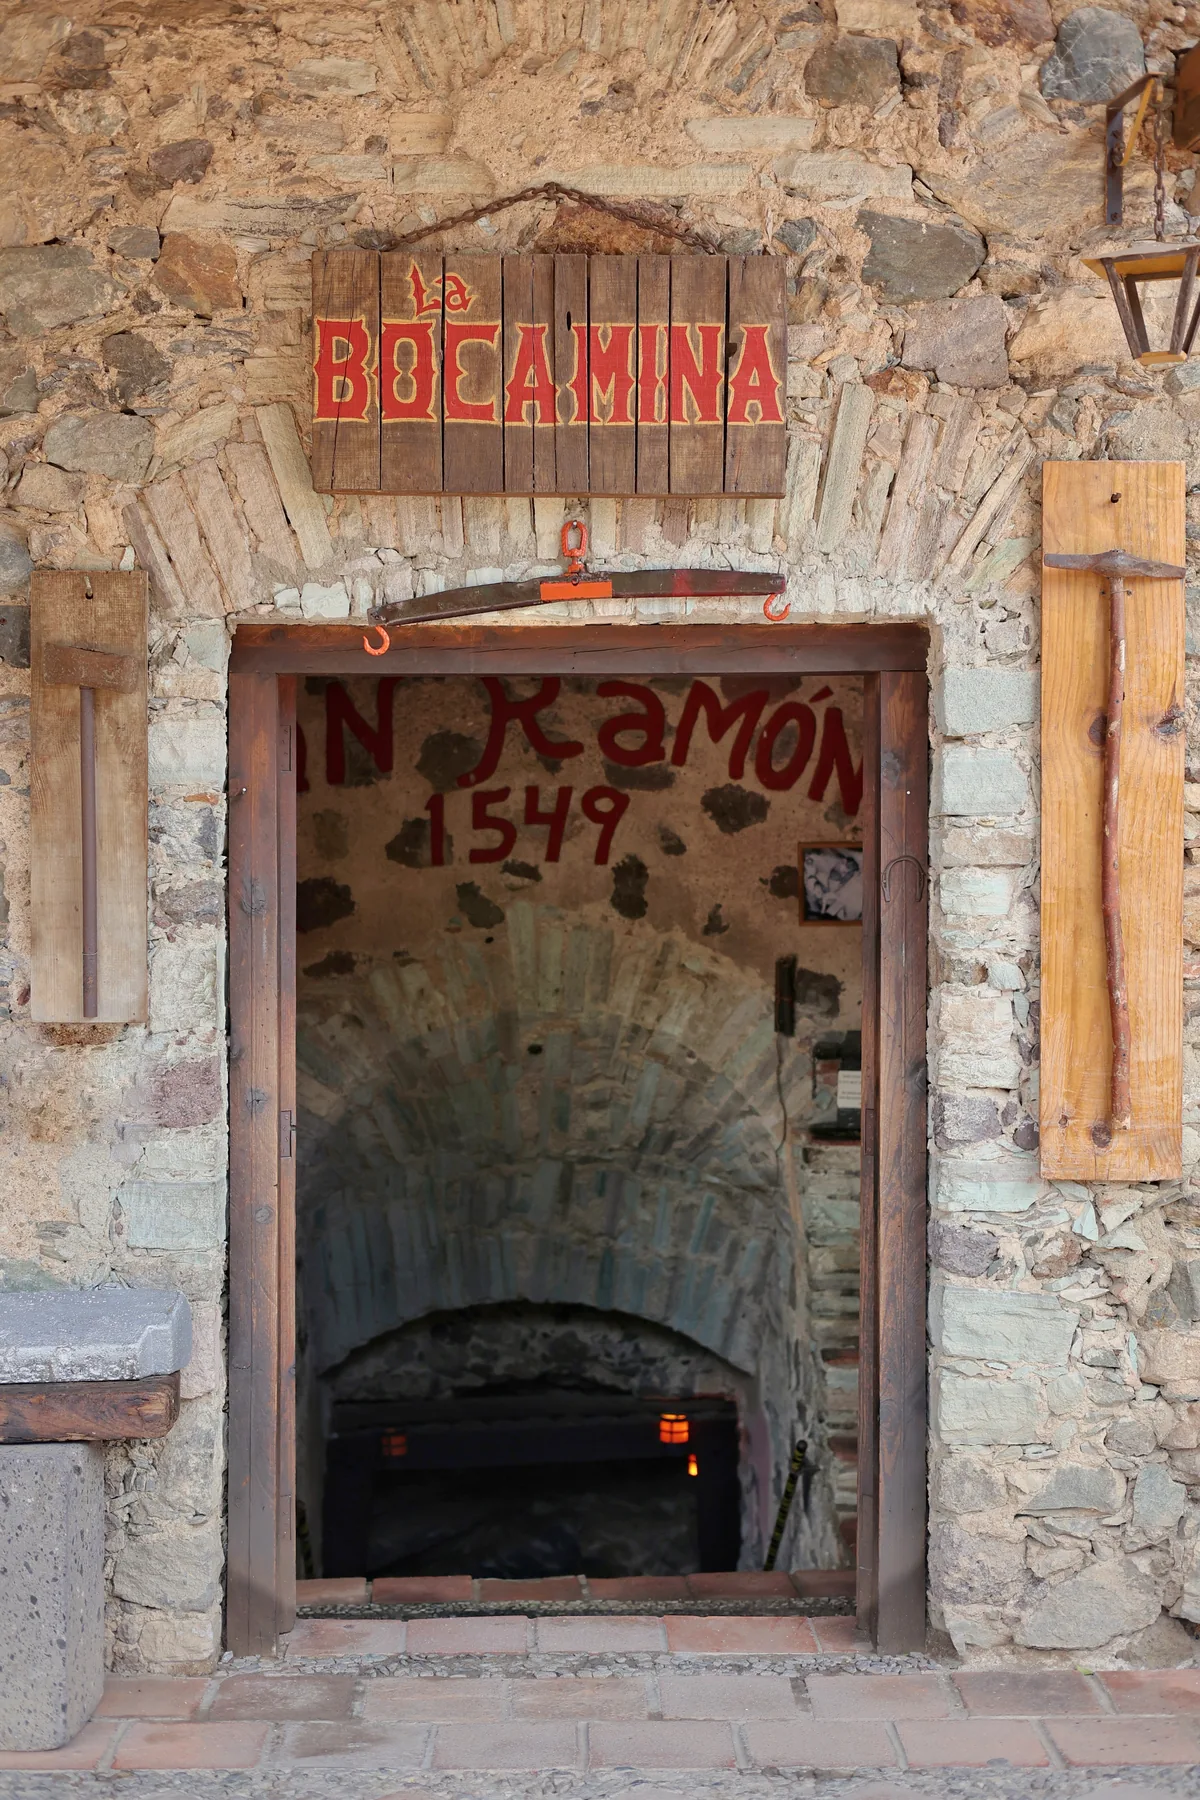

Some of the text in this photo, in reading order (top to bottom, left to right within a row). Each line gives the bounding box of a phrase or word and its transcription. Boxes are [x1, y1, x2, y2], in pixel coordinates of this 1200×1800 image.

[407, 260, 479, 318] La
[313, 316, 786, 427] BOCAMINA
[296, 676, 404, 793] N
[424, 785, 631, 867] 1549
